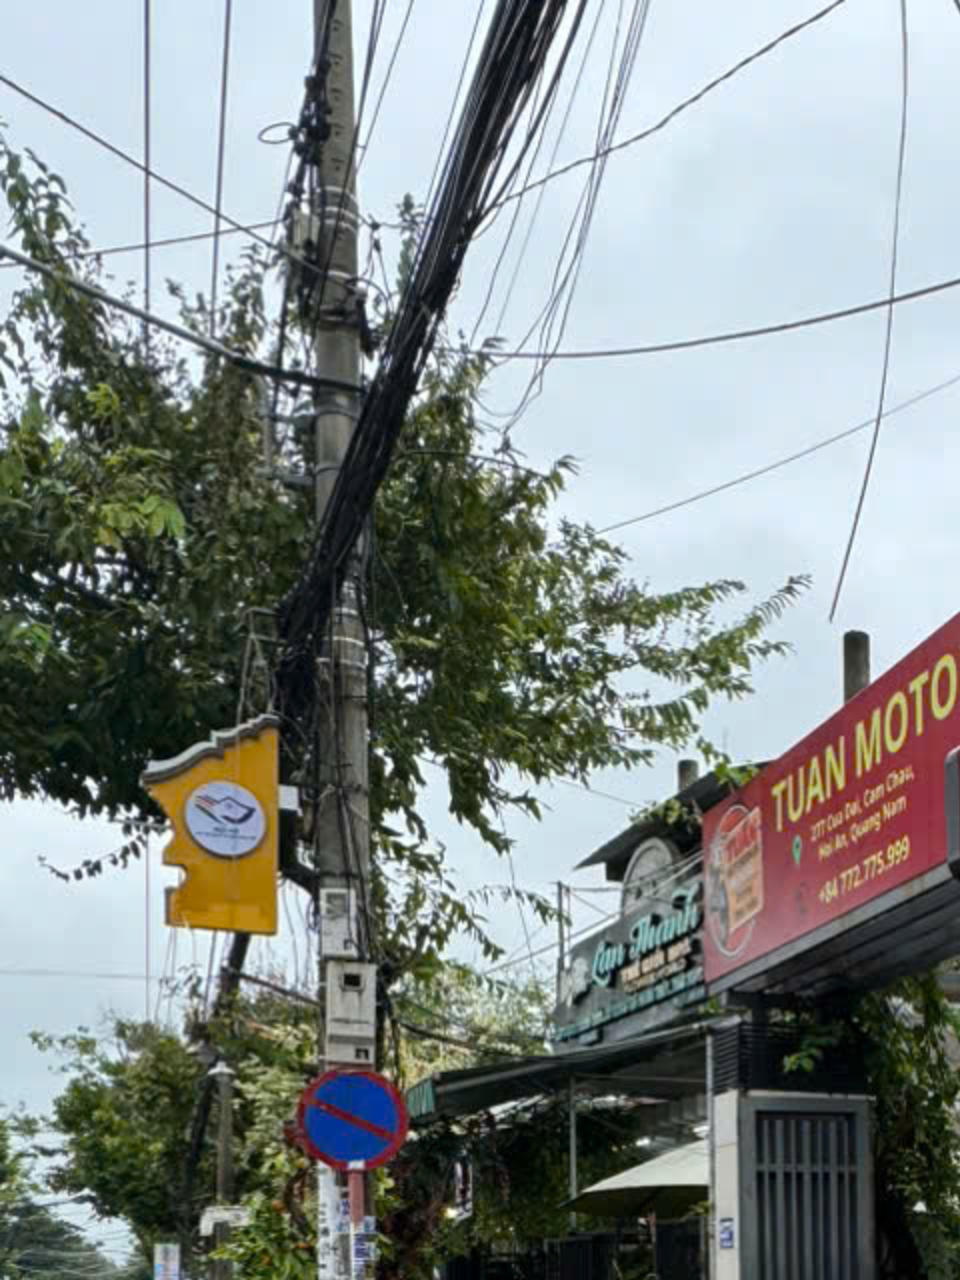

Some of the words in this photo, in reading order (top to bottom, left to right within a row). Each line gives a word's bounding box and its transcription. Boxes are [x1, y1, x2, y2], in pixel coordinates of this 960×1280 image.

[771, 735, 846, 832] TUAN
[864, 783, 885, 808] Cam
[882, 796, 907, 820] Nam
[840, 835, 911, 891] 772.775.999
